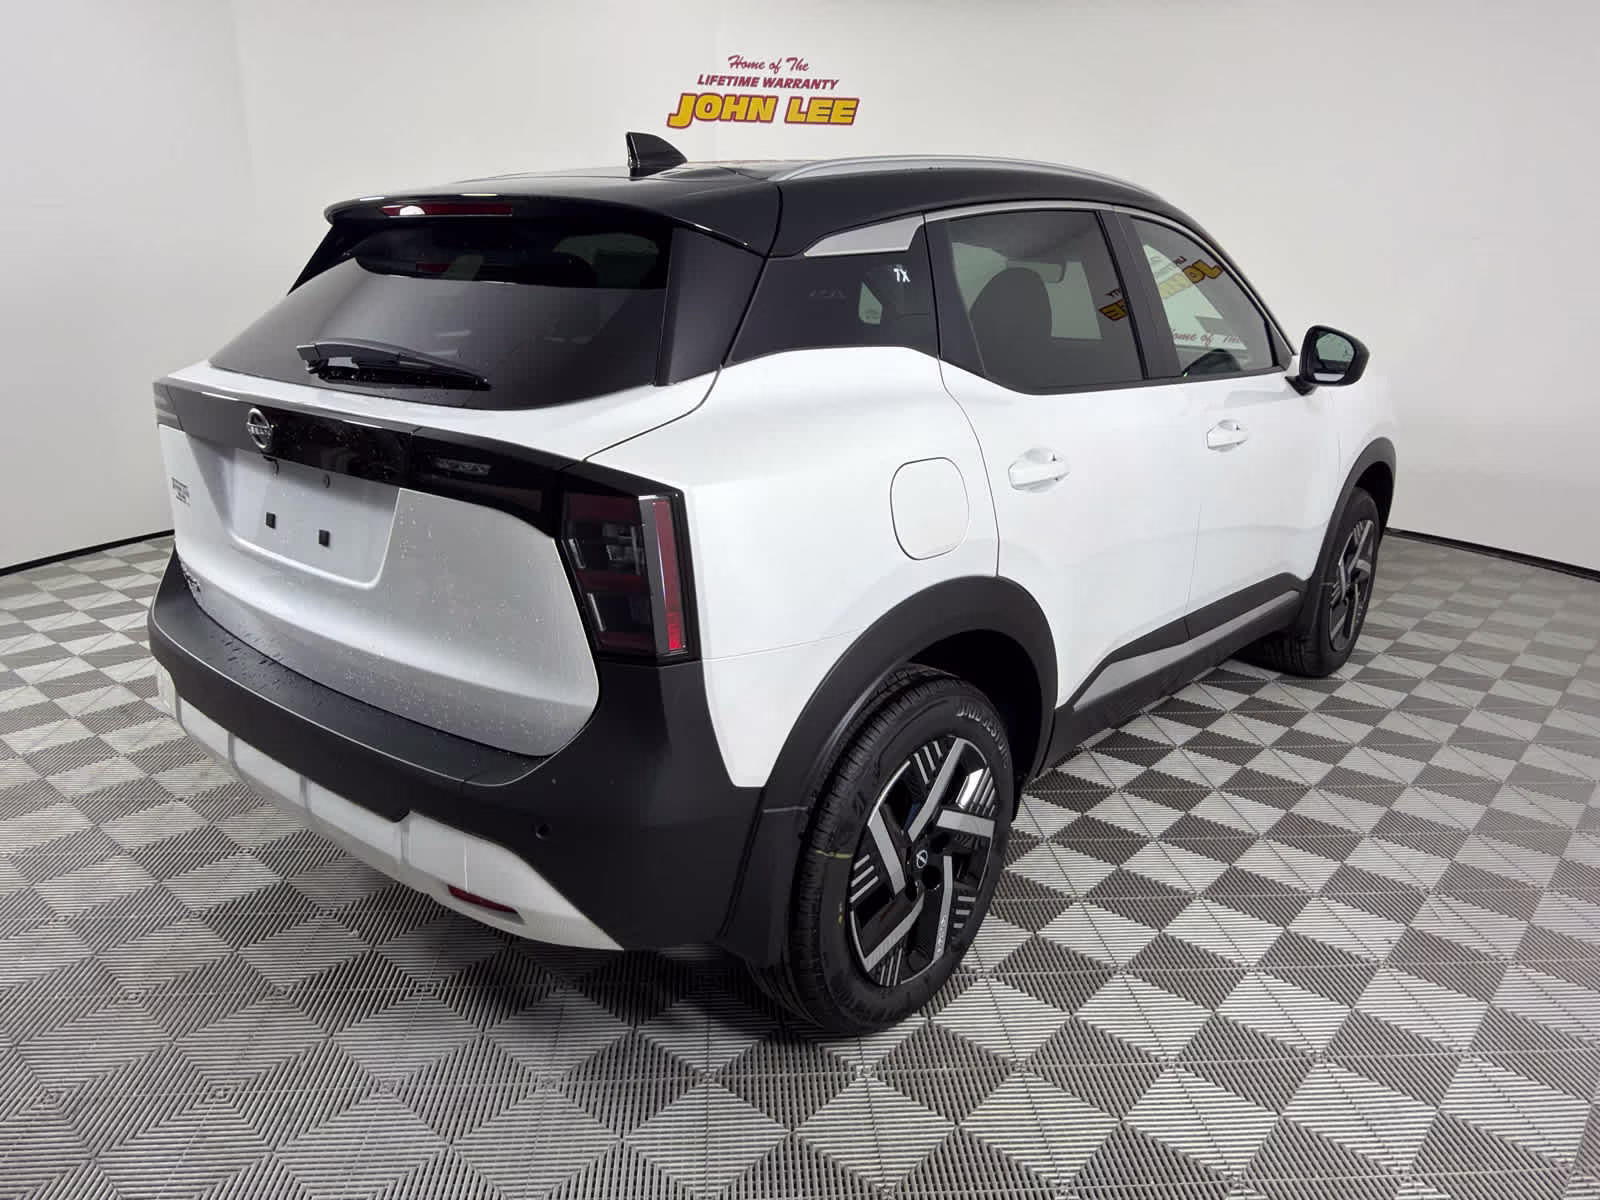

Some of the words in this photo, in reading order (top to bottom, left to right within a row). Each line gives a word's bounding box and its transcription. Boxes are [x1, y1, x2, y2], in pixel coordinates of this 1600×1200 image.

[727, 54, 766, 70] Home
[768, 58, 782, 74] of
[785, 57, 809, 71] The
[697, 74, 761, 88] LIFETIME
[762, 77, 840, 90] WARRANTY
[667, 92, 779, 130] JOHN
[784, 95, 860, 126] LEE
